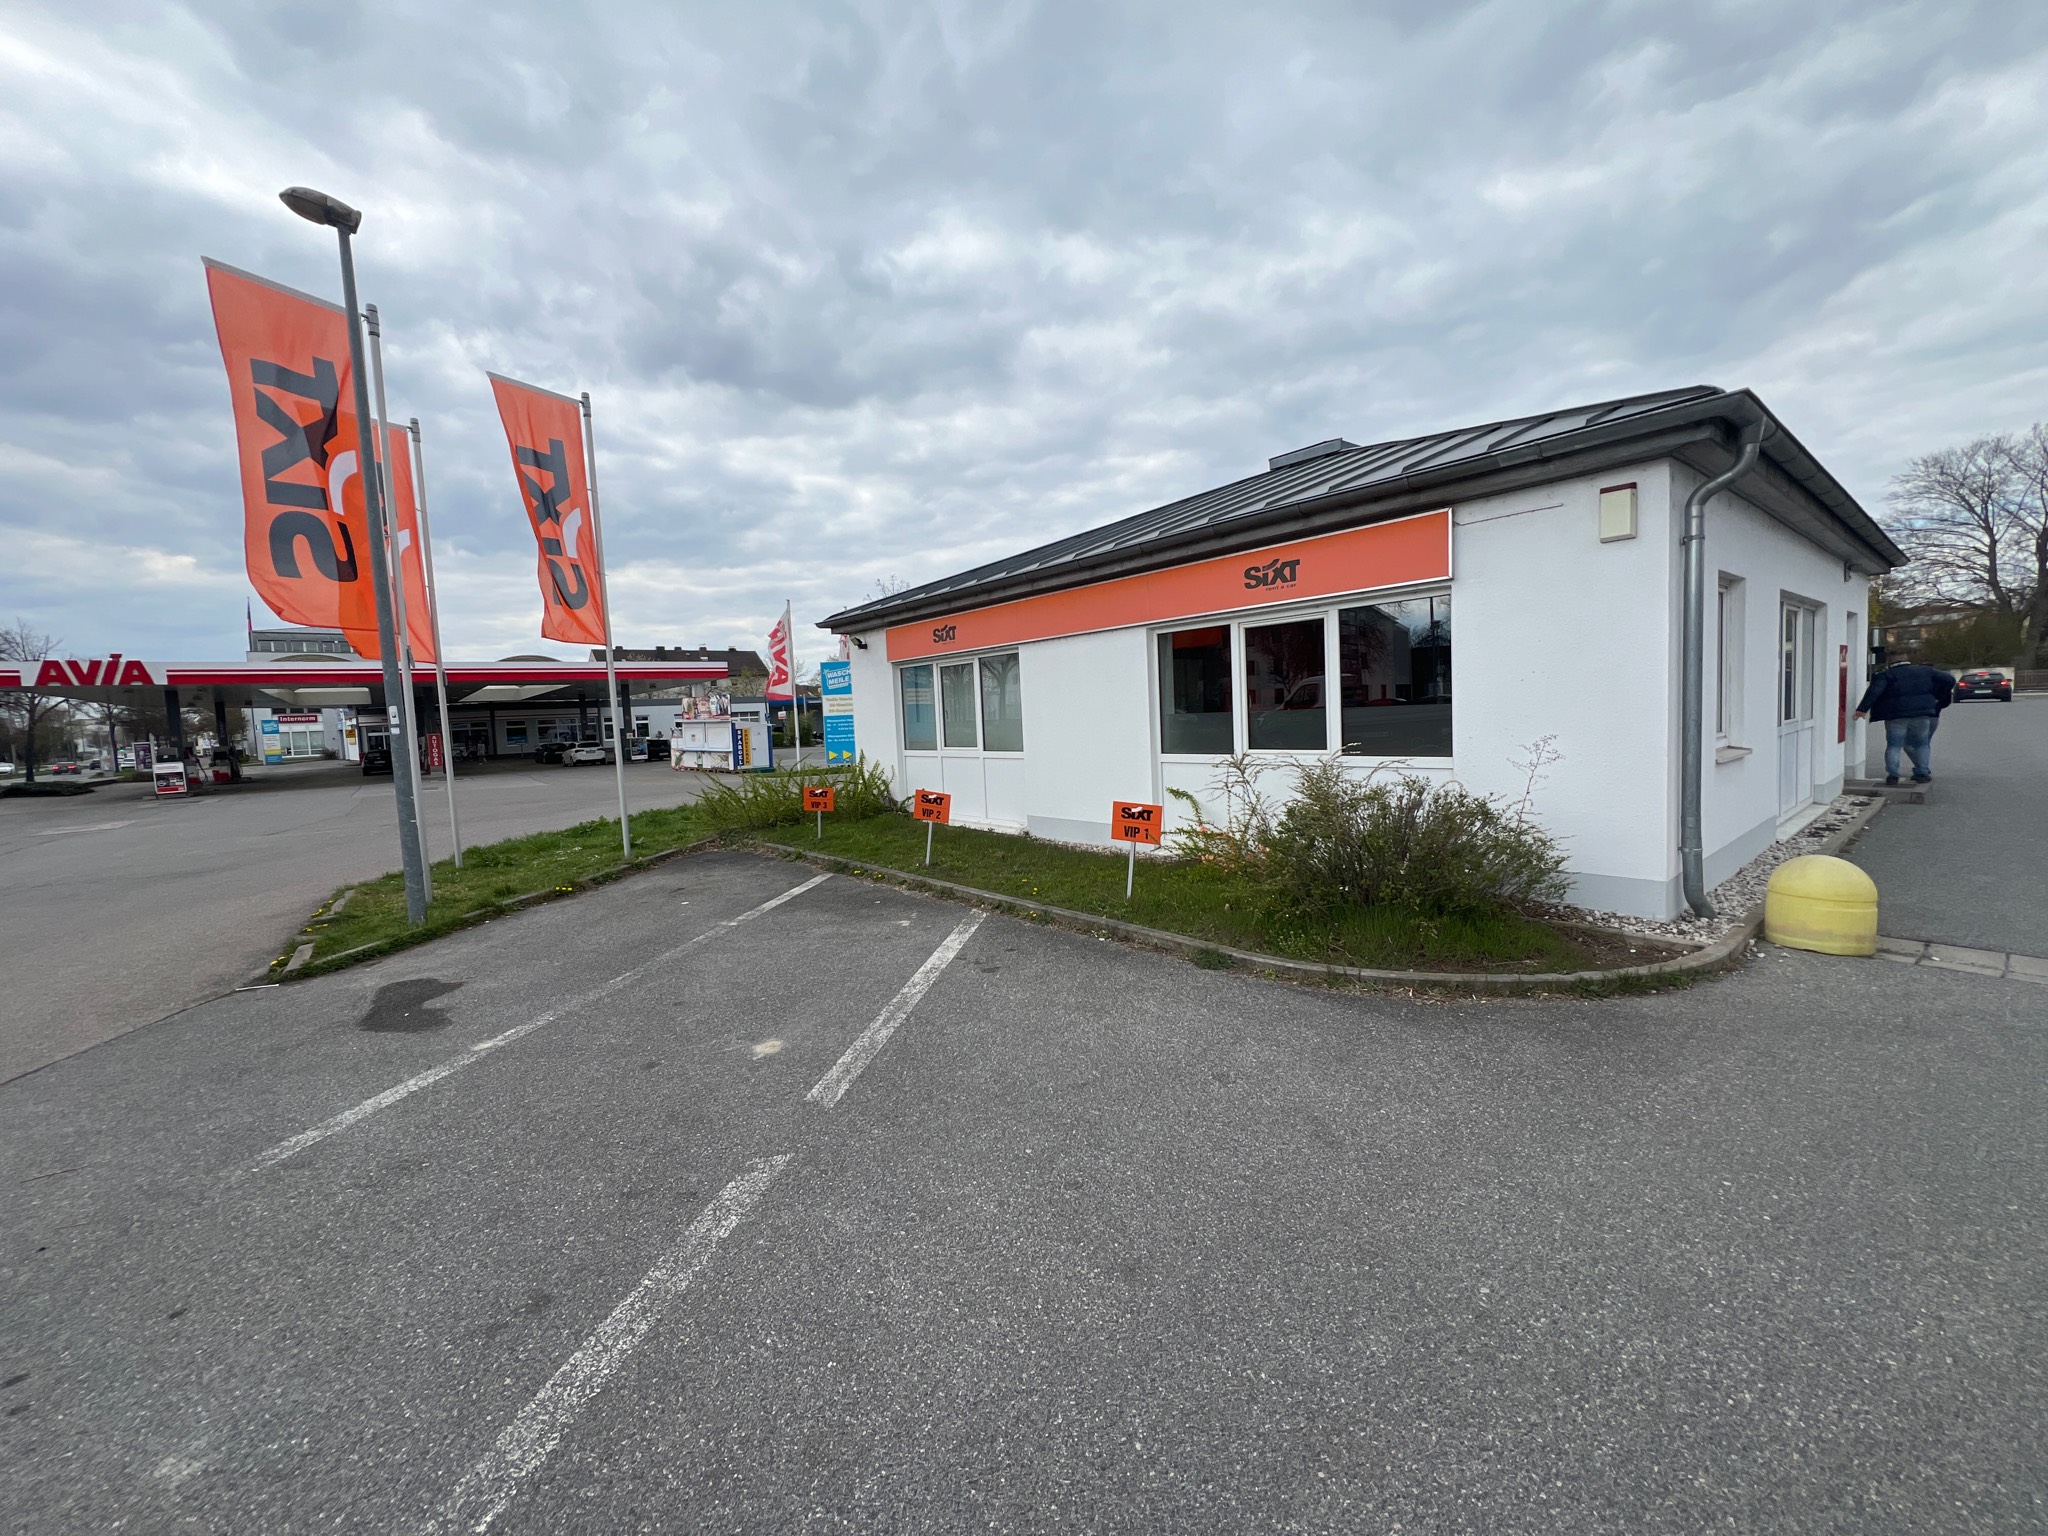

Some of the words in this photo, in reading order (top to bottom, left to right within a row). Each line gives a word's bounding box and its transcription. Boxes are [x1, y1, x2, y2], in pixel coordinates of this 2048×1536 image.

[35, 653, 155, 686] AVIA
[828, 676, 850, 685] MEILE
[431, 735, 439, 766] AUTOGAS
[811, 801, 821, 809] VIP
[823, 801, 827, 809] 3
[922, 808, 934, 818] VIP
[936, 810, 941, 820] 2
[1124, 825, 1140, 838] VIP
[1144, 828, 1149, 840] 1
